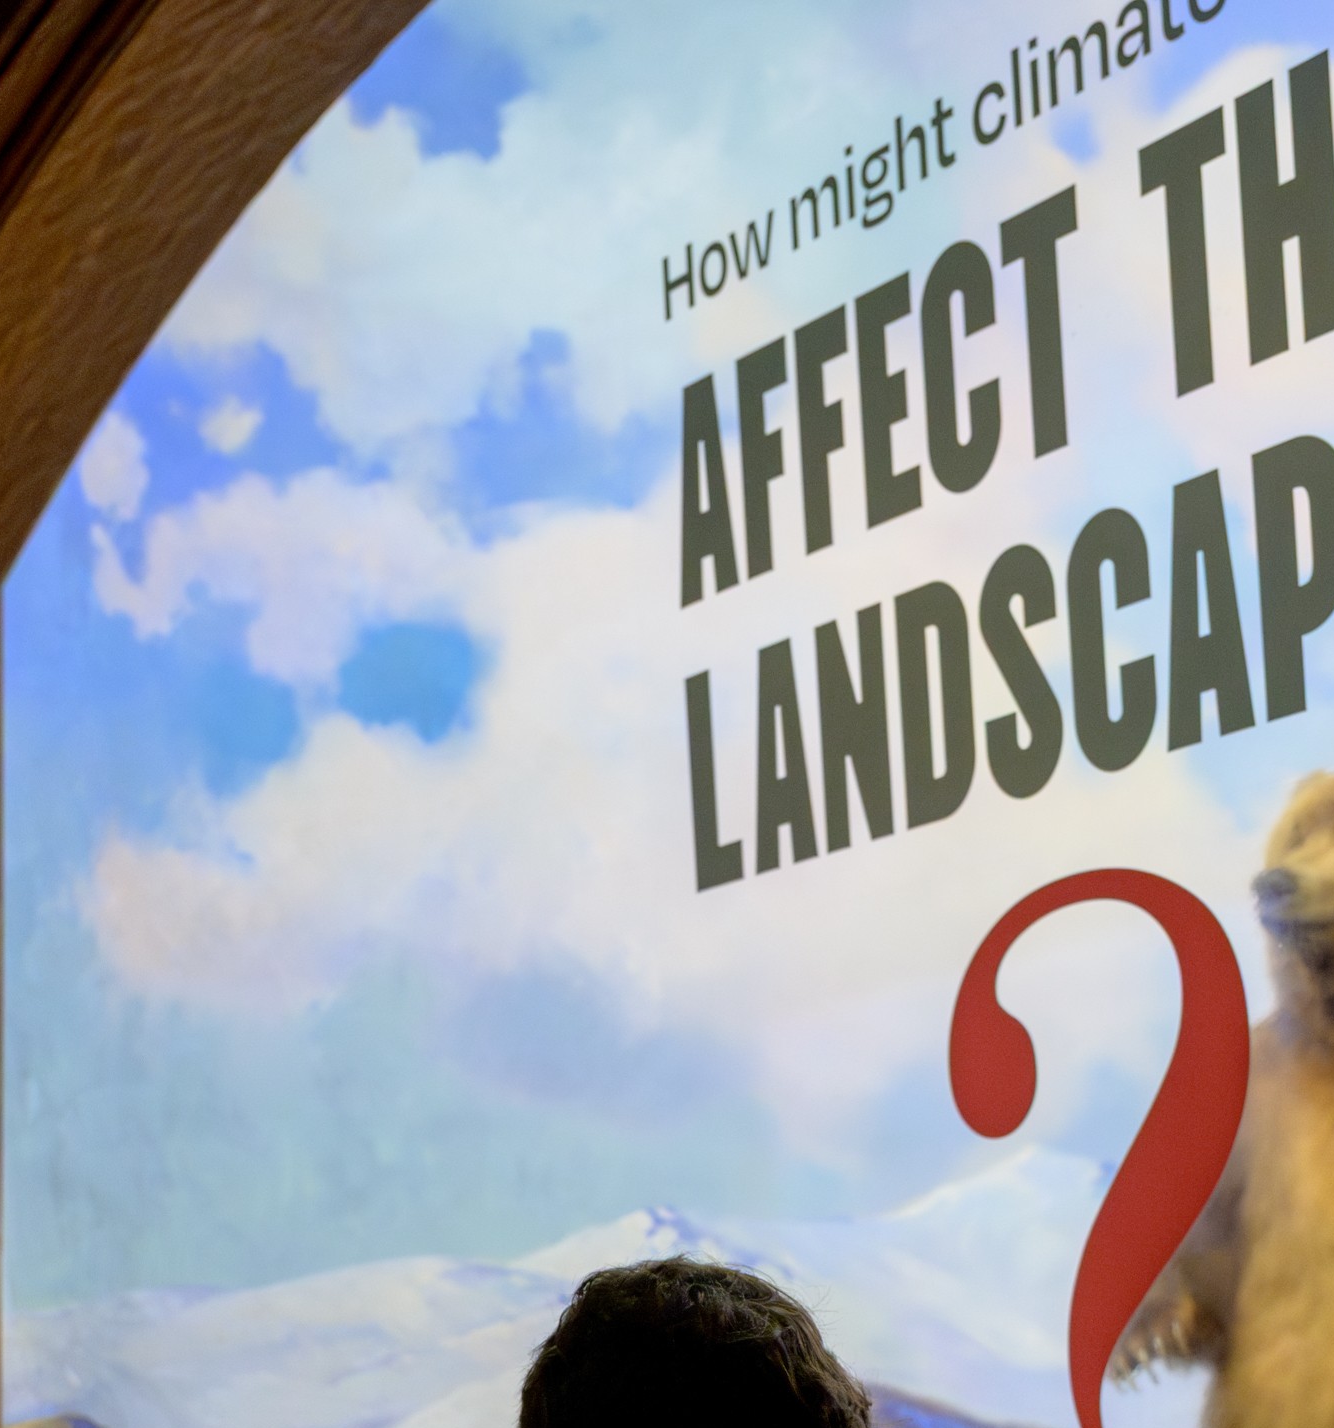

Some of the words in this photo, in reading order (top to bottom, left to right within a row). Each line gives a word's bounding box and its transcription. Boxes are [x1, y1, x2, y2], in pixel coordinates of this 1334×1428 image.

[662, 211, 774, 320] How
[790, 99, 955, 251] might
[681, 184, 1078, 608] AFFECT
